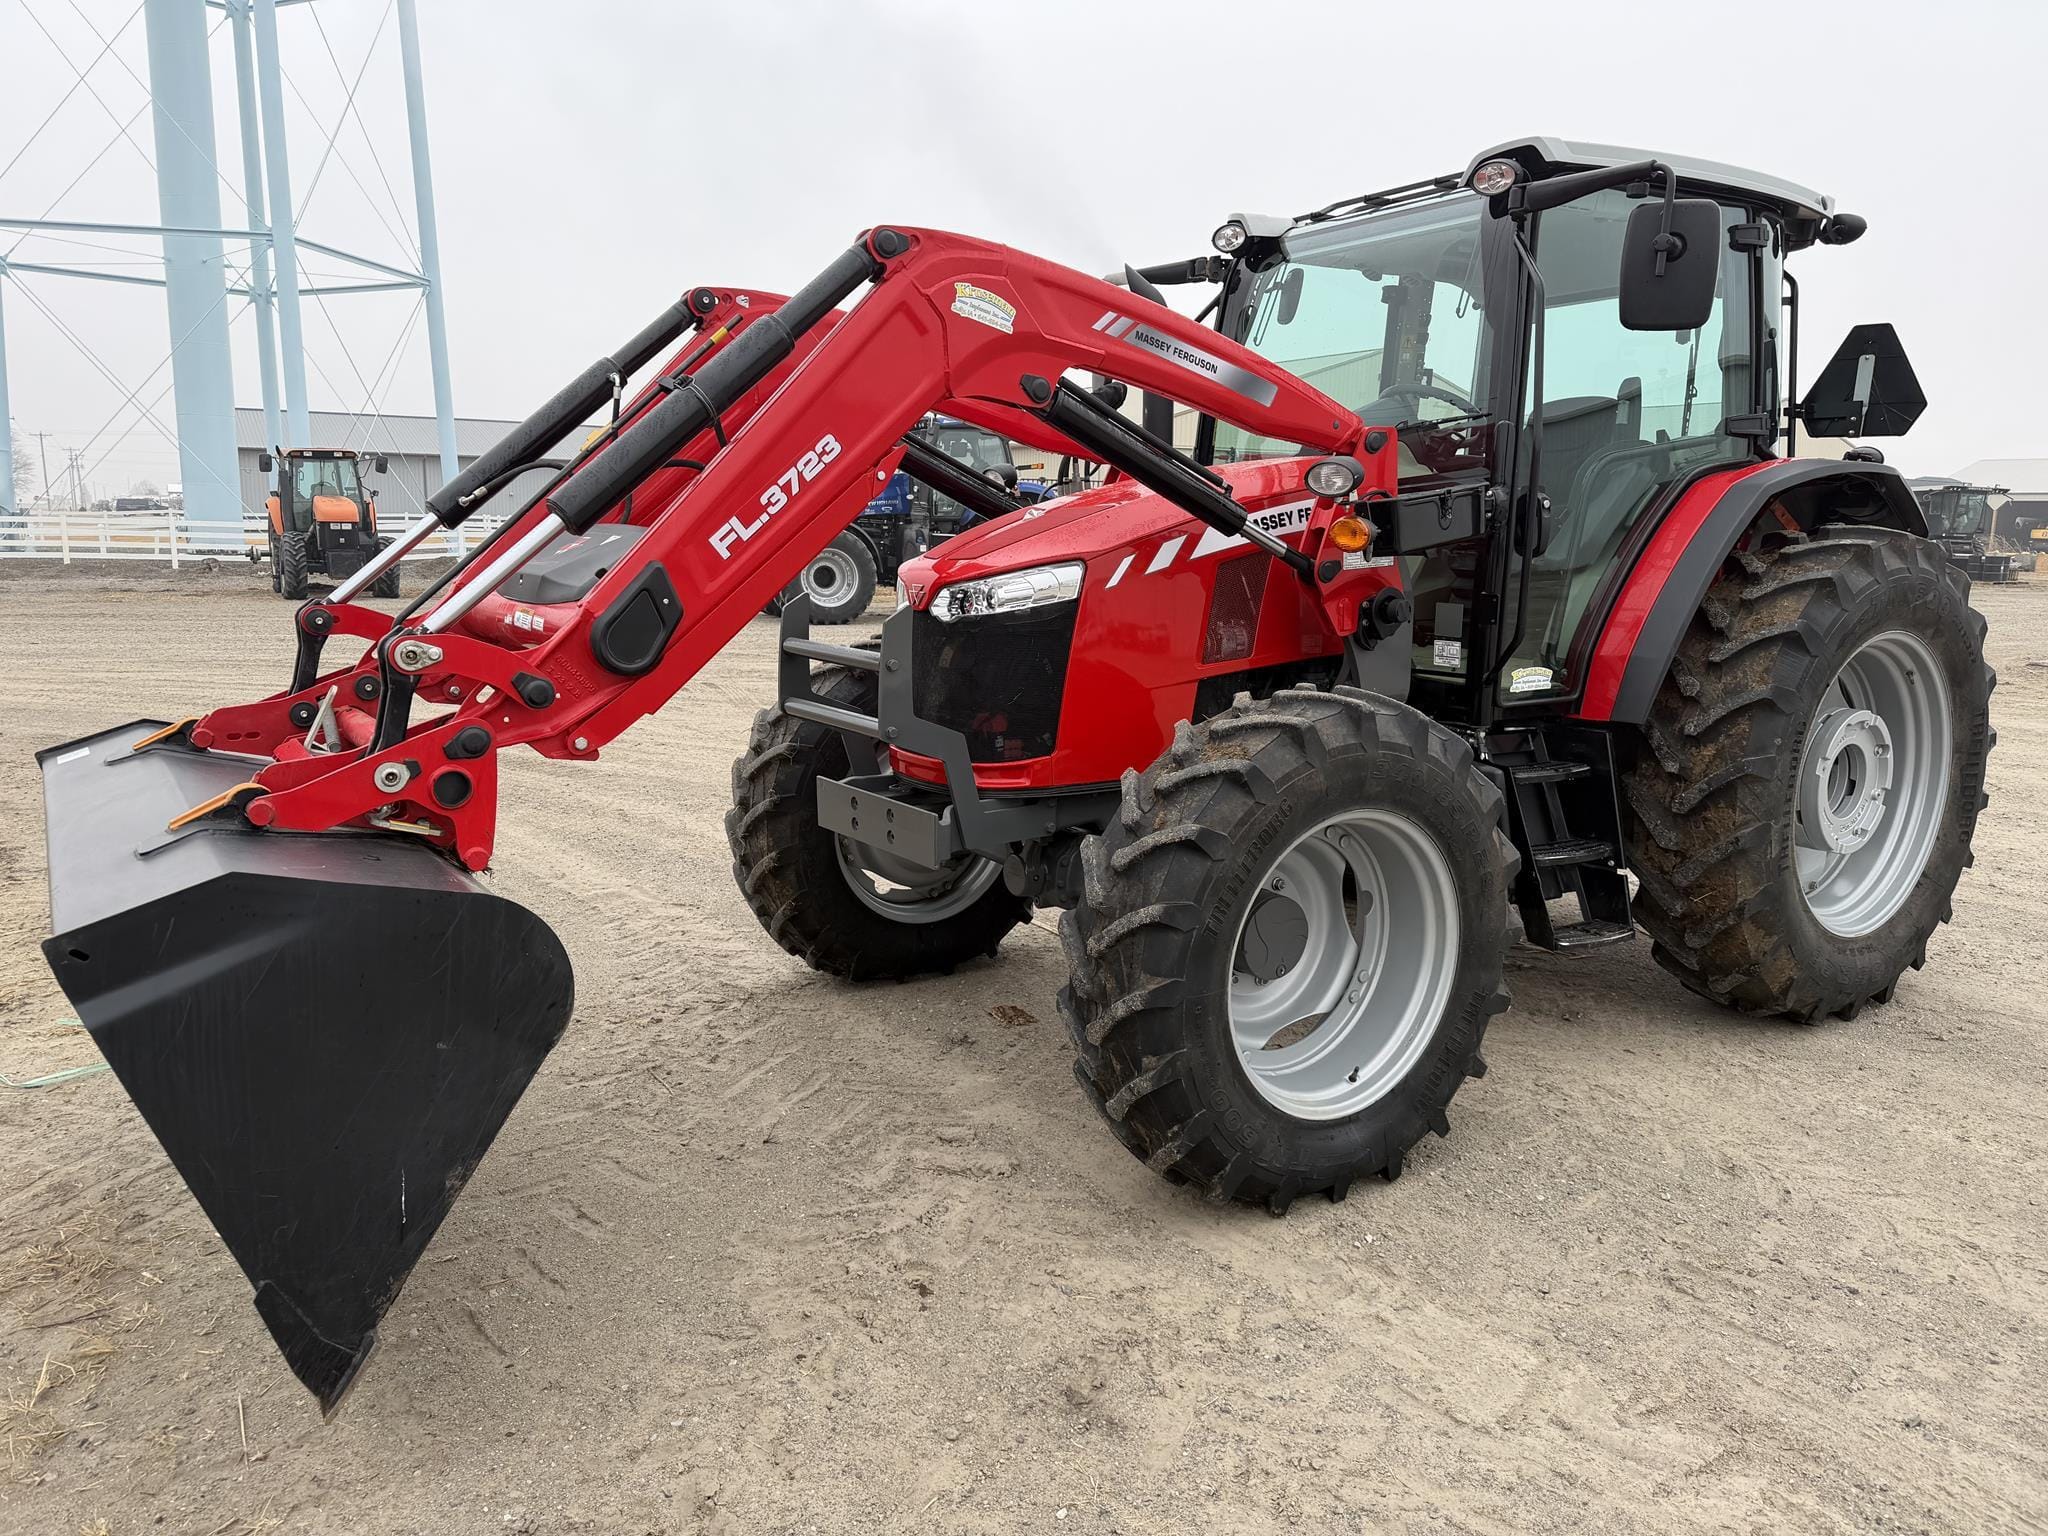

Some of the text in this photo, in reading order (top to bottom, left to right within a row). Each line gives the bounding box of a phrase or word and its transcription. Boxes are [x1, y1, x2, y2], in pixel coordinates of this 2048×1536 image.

[1135, 330, 1218, 374] MASSEY FERGUSON
[708, 433, 842, 560] FL.3723
[1252, 510, 1293, 532] ASSEY
